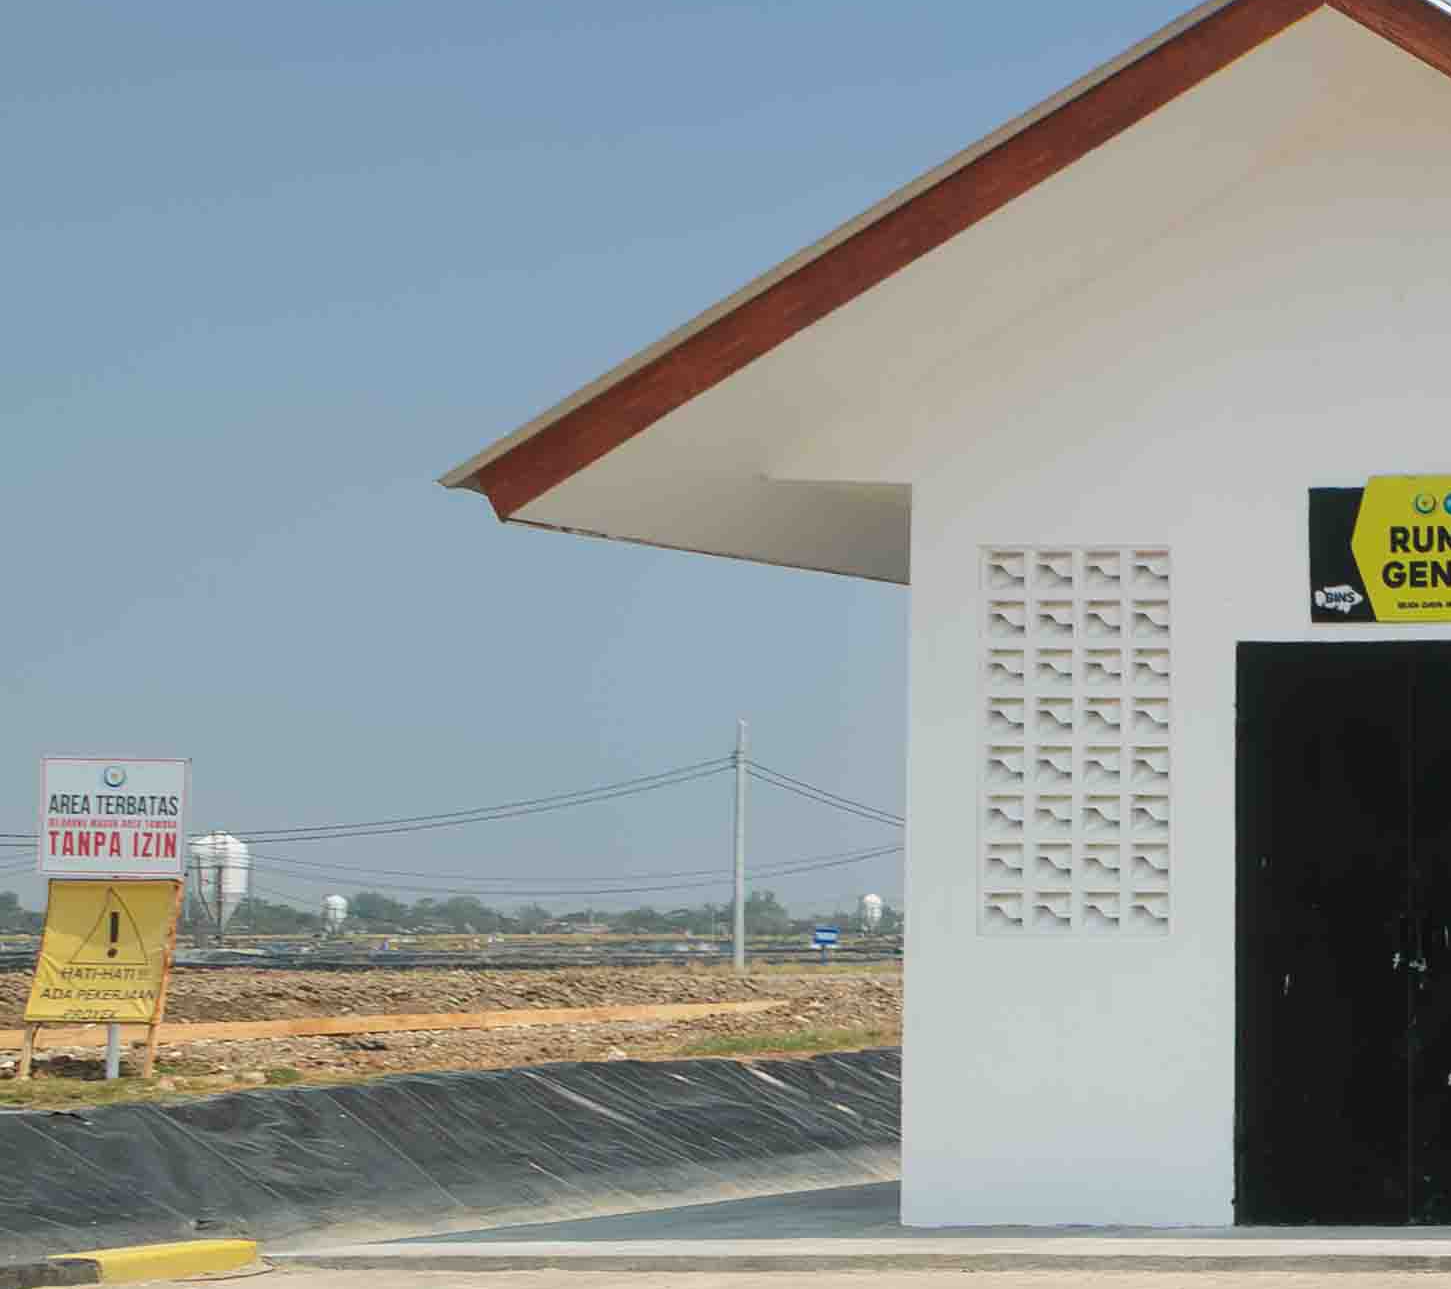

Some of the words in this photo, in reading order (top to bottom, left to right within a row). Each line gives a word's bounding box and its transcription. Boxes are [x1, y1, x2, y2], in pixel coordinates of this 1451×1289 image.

[48, 794, 90, 815] AREA
[96, 795, 178, 817] TERBATAS
[49, 831, 121, 857] TANPA
[133, 832, 177, 859] IZIN
